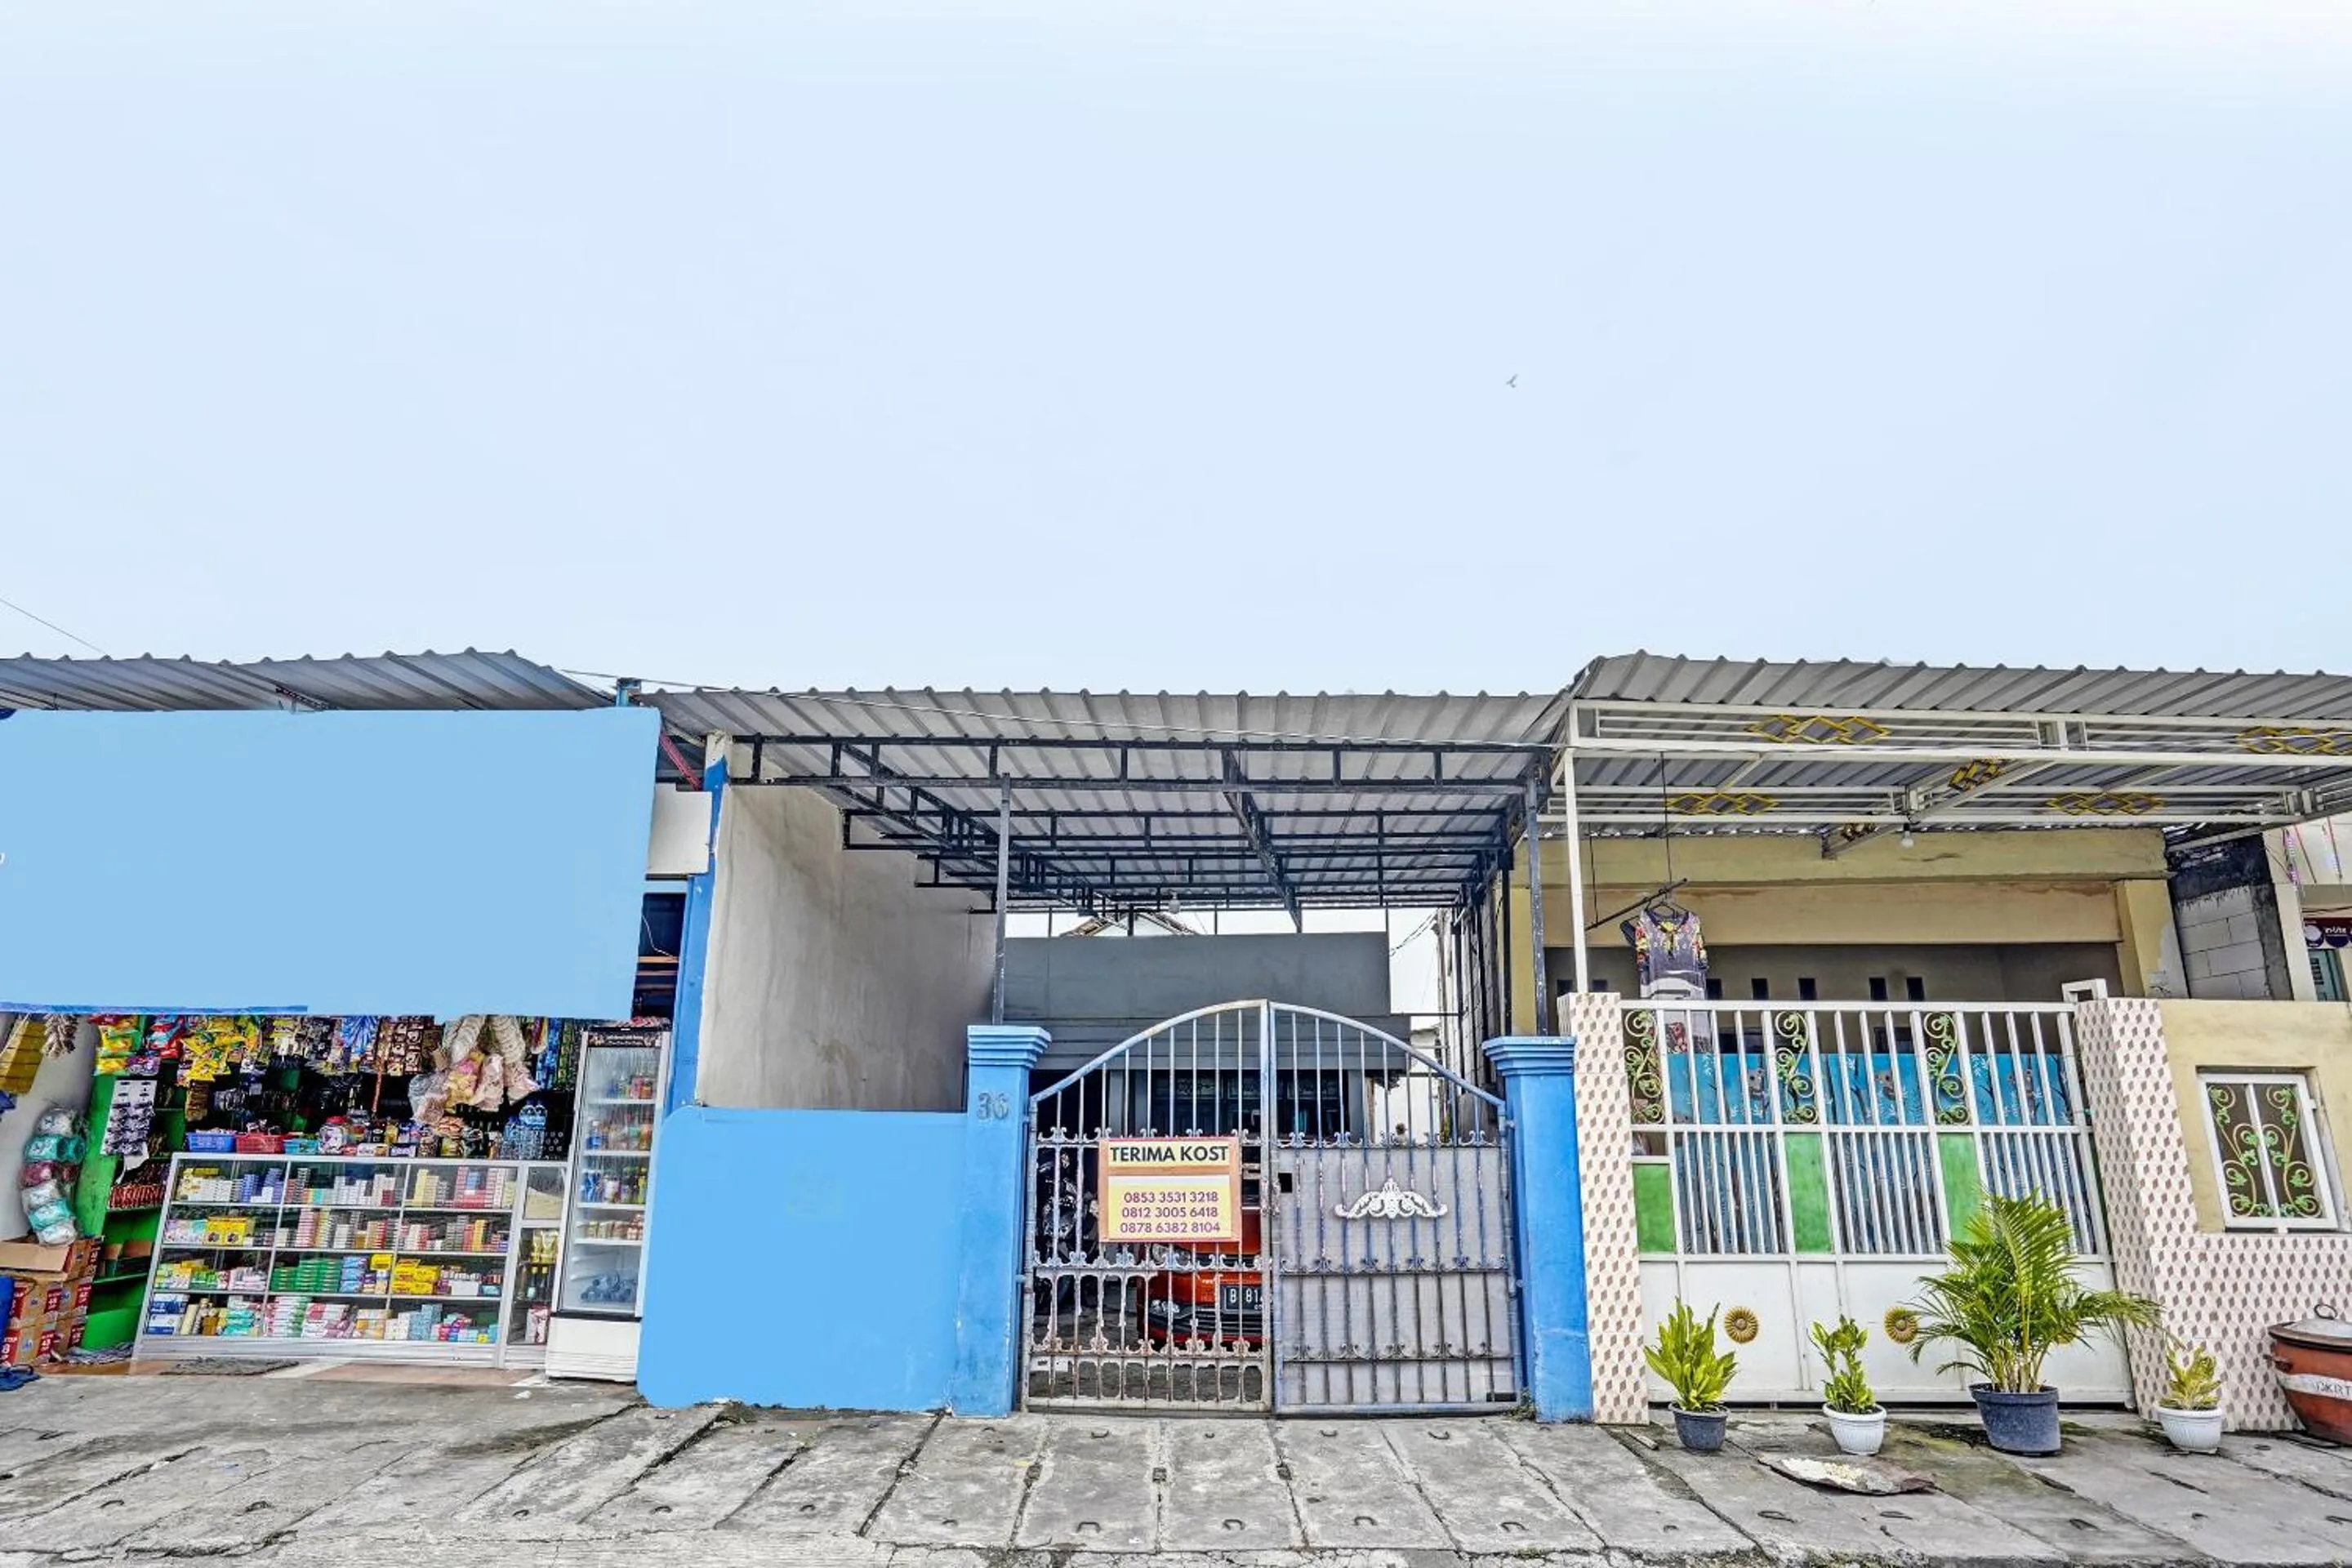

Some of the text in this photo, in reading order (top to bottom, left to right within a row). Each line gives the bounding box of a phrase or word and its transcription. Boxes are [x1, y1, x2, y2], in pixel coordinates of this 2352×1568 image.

[977, 1092, 1009, 1120] 36
[1110, 1145, 1229, 1161] TERIMA KOST
[1124, 1191, 1218, 1203] 0853 3531 3218
[1121, 1206, 1218, 1218] 0812 3005 6418
[1120, 1223, 1220, 1233] 0878 6382 8104
[1245, 1288, 1263, 1303] 81
